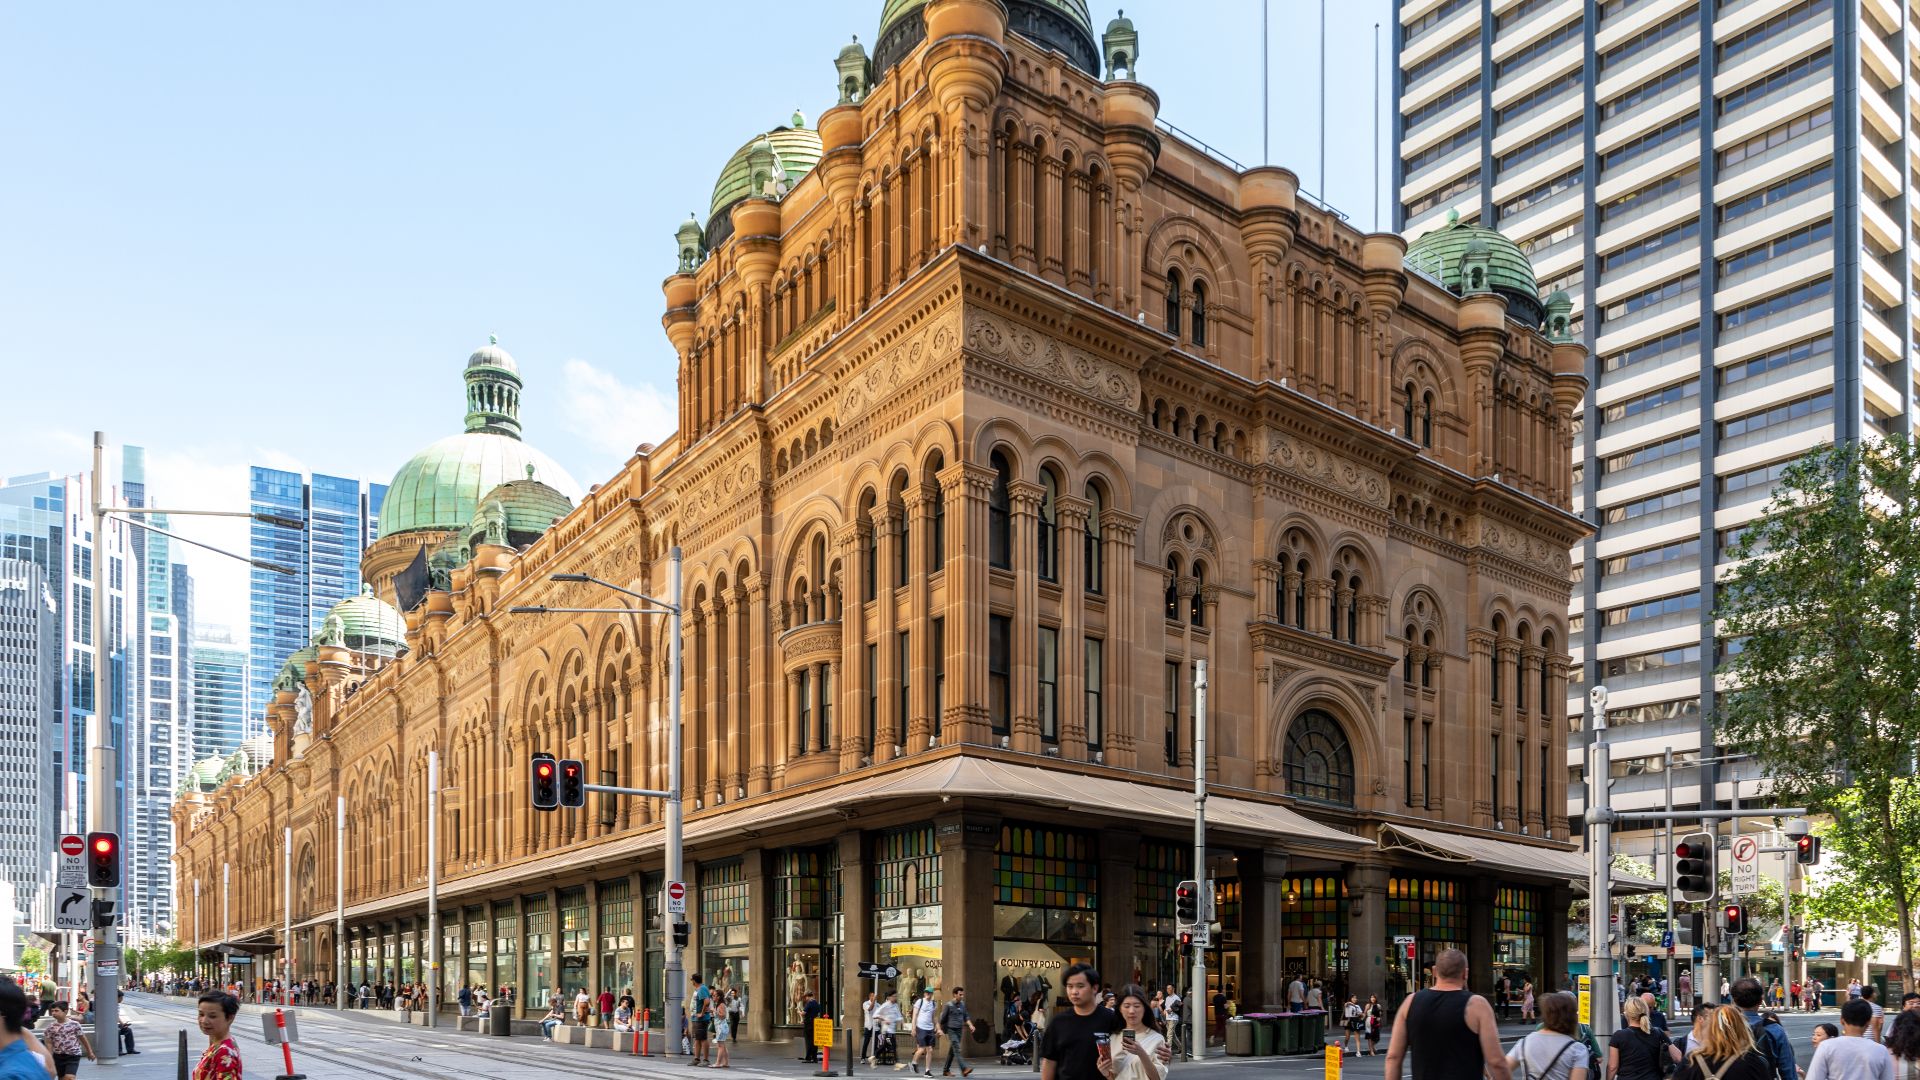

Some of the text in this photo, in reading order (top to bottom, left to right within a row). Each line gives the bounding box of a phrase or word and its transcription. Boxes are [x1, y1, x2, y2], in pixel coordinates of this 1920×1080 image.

[1737, 864, 1752, 874] NO
[57, 917, 87, 925] ONLY
[1000, 958, 1061, 969] COUNTRY ROAD
